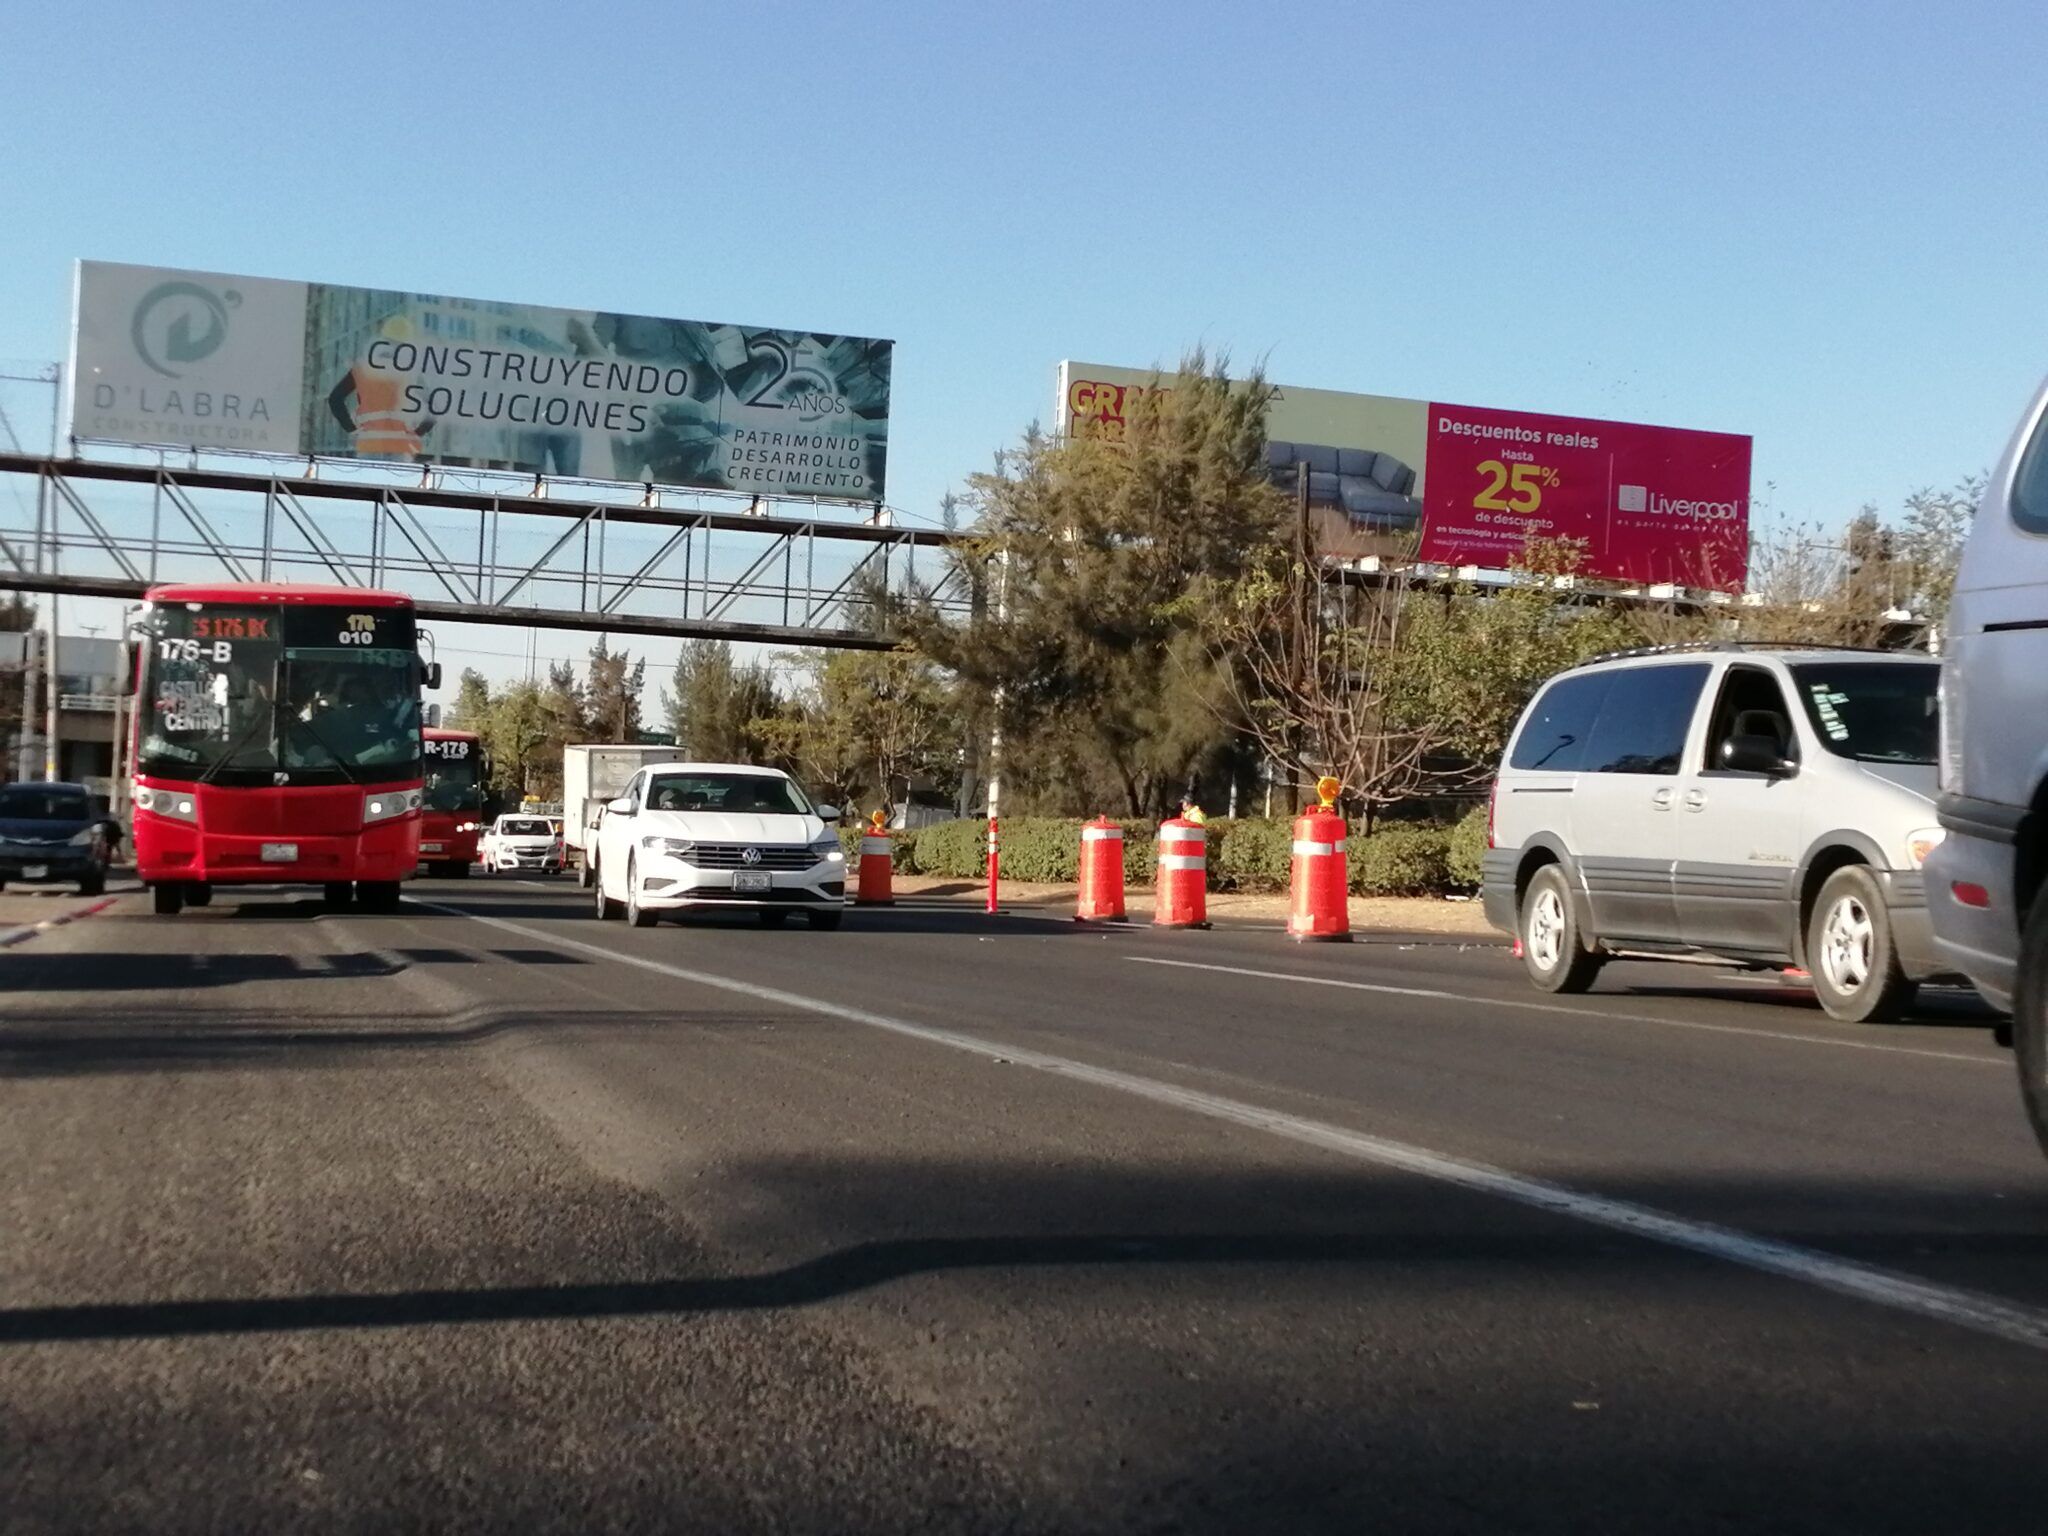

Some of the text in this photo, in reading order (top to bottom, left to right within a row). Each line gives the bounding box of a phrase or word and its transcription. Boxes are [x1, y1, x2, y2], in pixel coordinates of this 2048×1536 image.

[367, 340, 689, 397] CONSTRUYENDO
[94, 383, 270, 422] D'LABRA
[401, 384, 649, 433] SOLUCIONES
[787, 392, 846, 414] AÑOS
[92, 416, 269, 442] CONSTRUCTORA
[733, 429, 860, 452] PATRIMONIO
[1438, 417, 1599, 449] Descuentos reales
[731, 447, 861, 470] DESARROLLO
[1501, 448, 1535, 463] Hasta
[726, 466, 864, 488] CRECIMIENTO
[1472, 459, 1561, 514] 25%
[1649, 492, 1738, 523] Liverpool
[1475, 511, 1554, 529] de descuento
[424, 740, 469, 755] R-178
